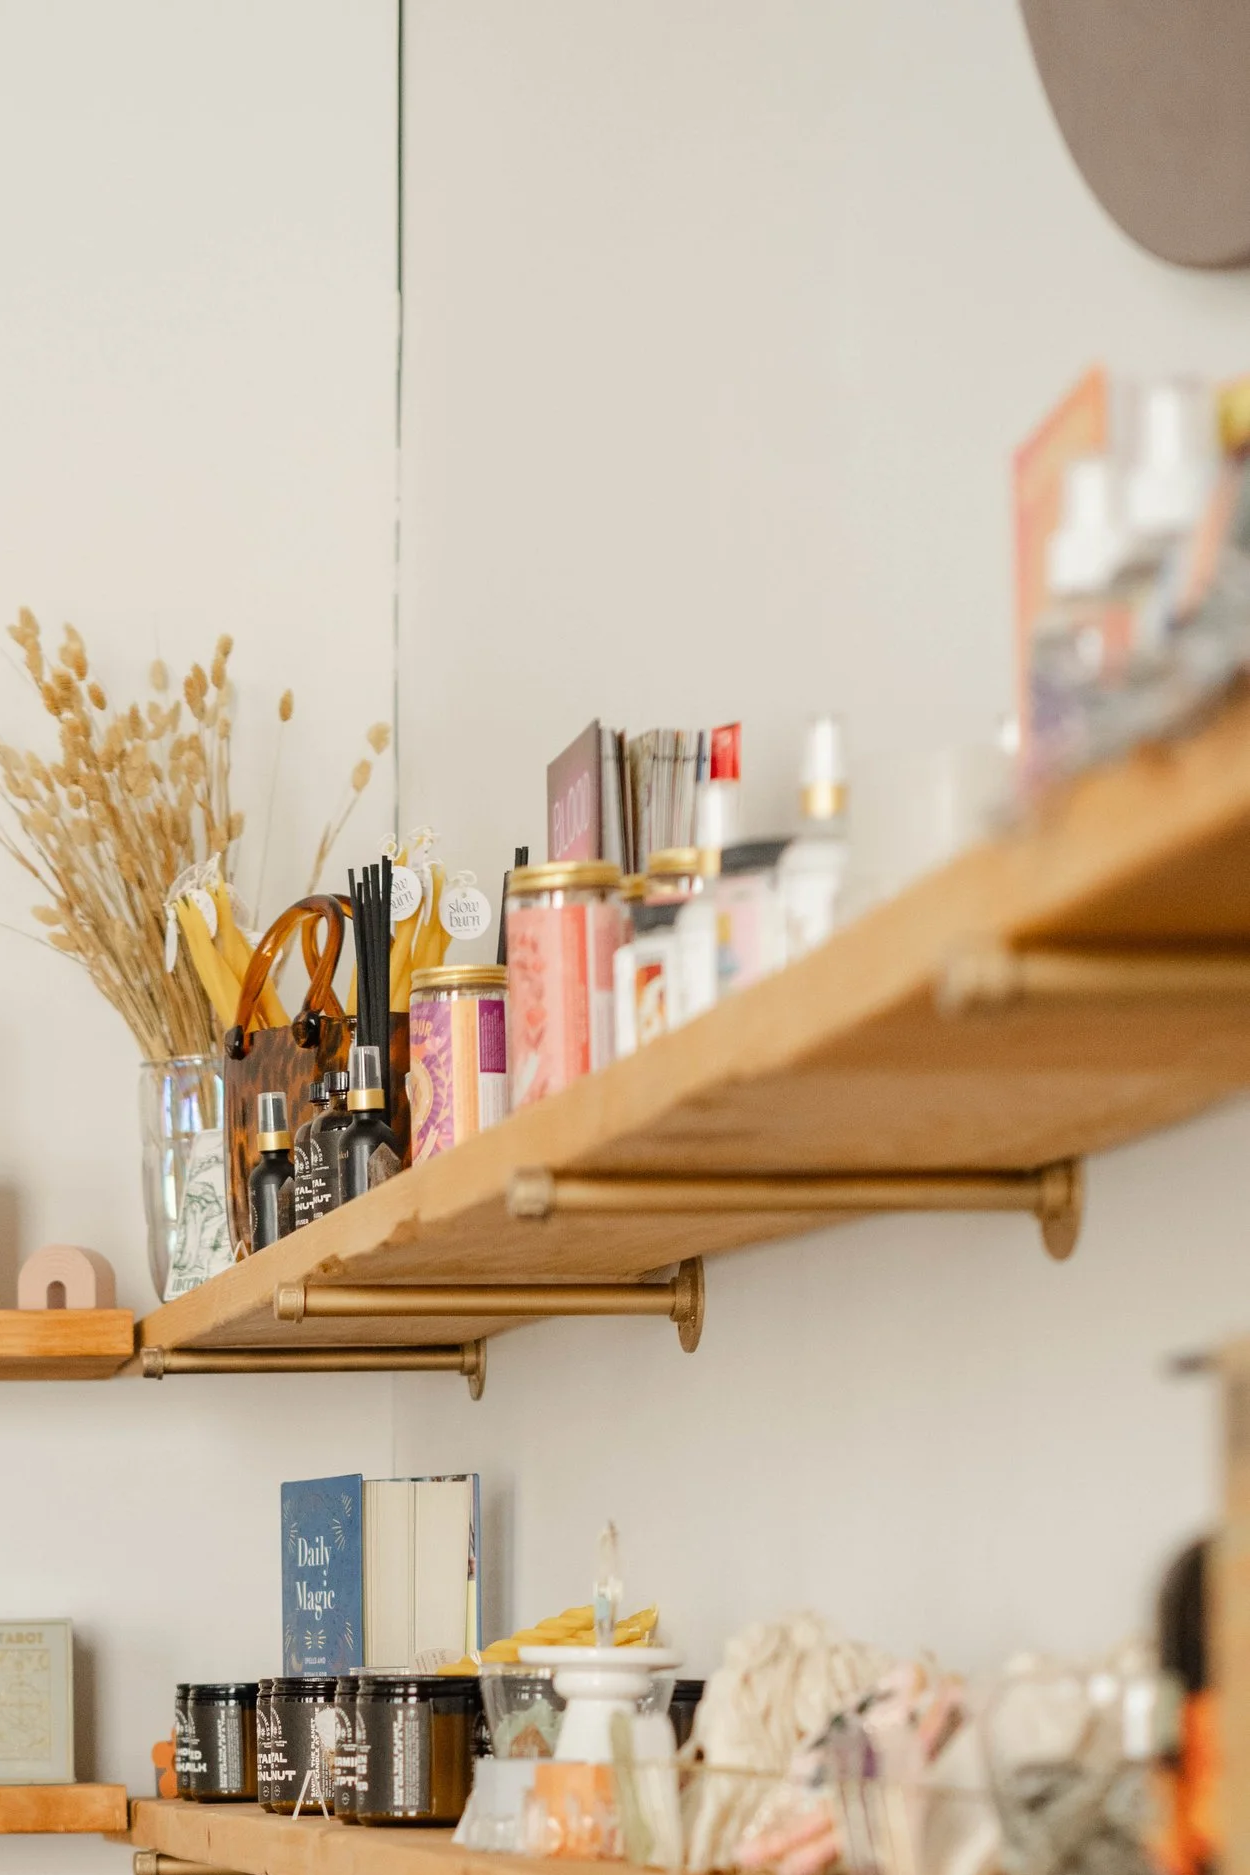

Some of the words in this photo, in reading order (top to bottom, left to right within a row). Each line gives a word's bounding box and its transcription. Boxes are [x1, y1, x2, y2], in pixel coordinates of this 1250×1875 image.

[448, 898, 479, 913] slow
[450, 912, 480, 928] burn
[298, 1536, 331, 1575] Daily
[295, 1580, 336, 1620] Magic
